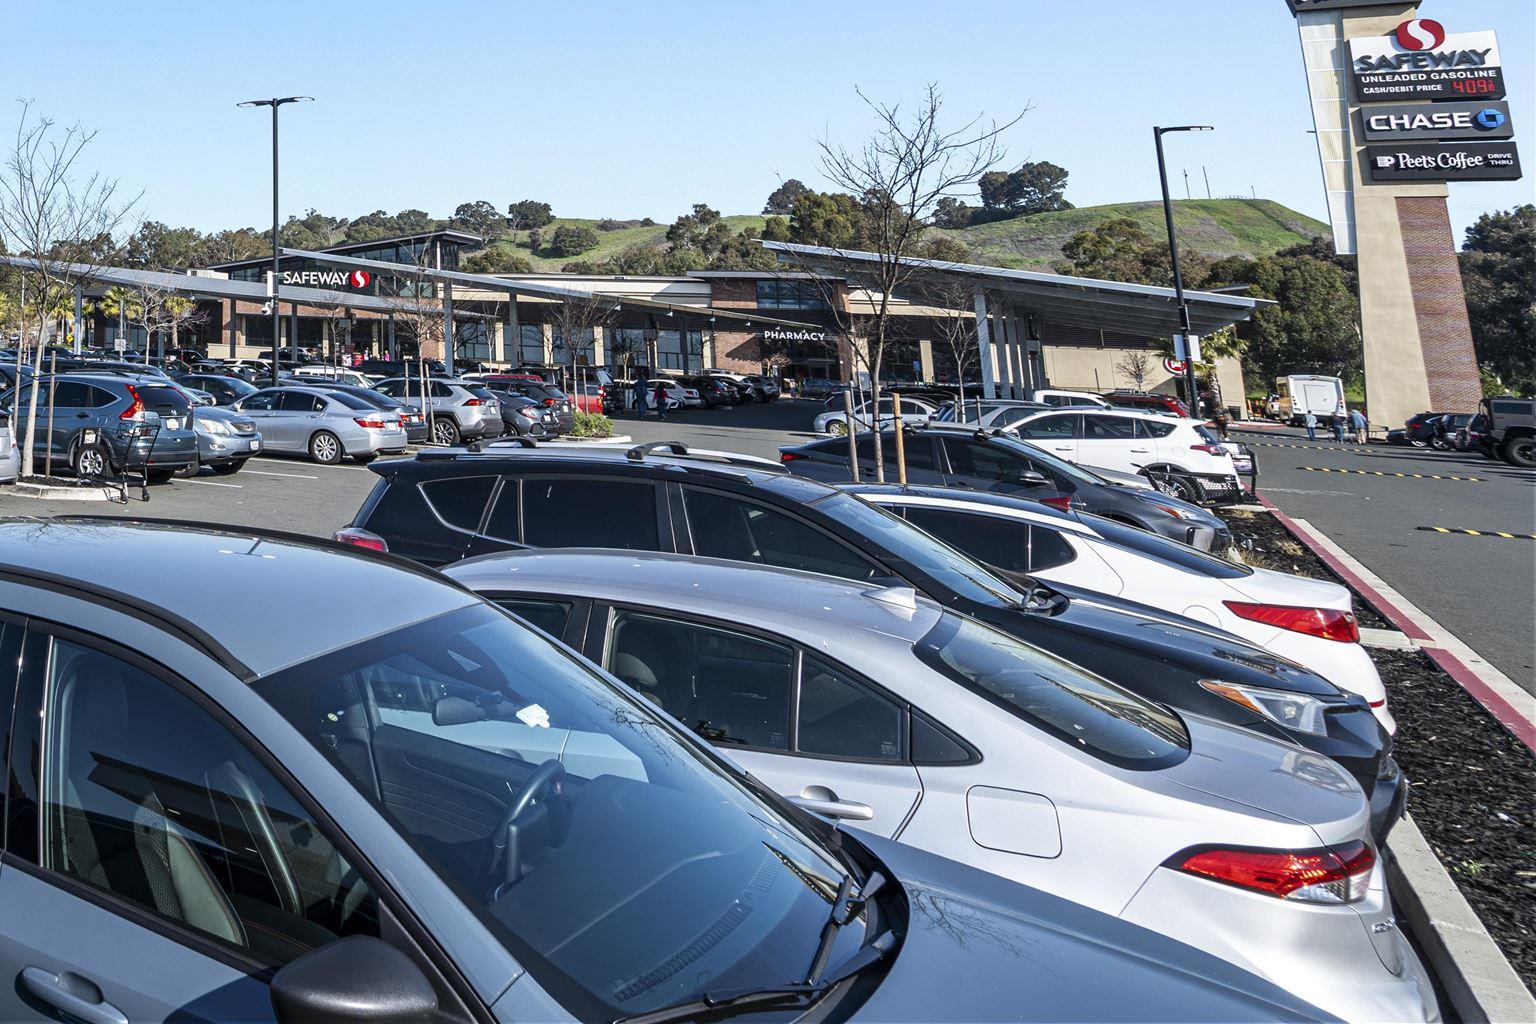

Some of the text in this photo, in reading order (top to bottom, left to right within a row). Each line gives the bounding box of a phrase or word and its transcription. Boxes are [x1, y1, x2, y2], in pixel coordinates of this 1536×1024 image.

[1357, 48, 1492, 72] SAFEWAY
[1361, 69, 1497, 83] UNLEADED GASOLINE
[1363, 84, 1443, 94] CASH/DEBIT PRICE
[1369, 111, 1473, 130] CHASE
[1437, 152, 1483, 169] Coffee
[283, 271, 350, 286] SAFEWAY
[764, 331, 825, 341] PHARMACY
